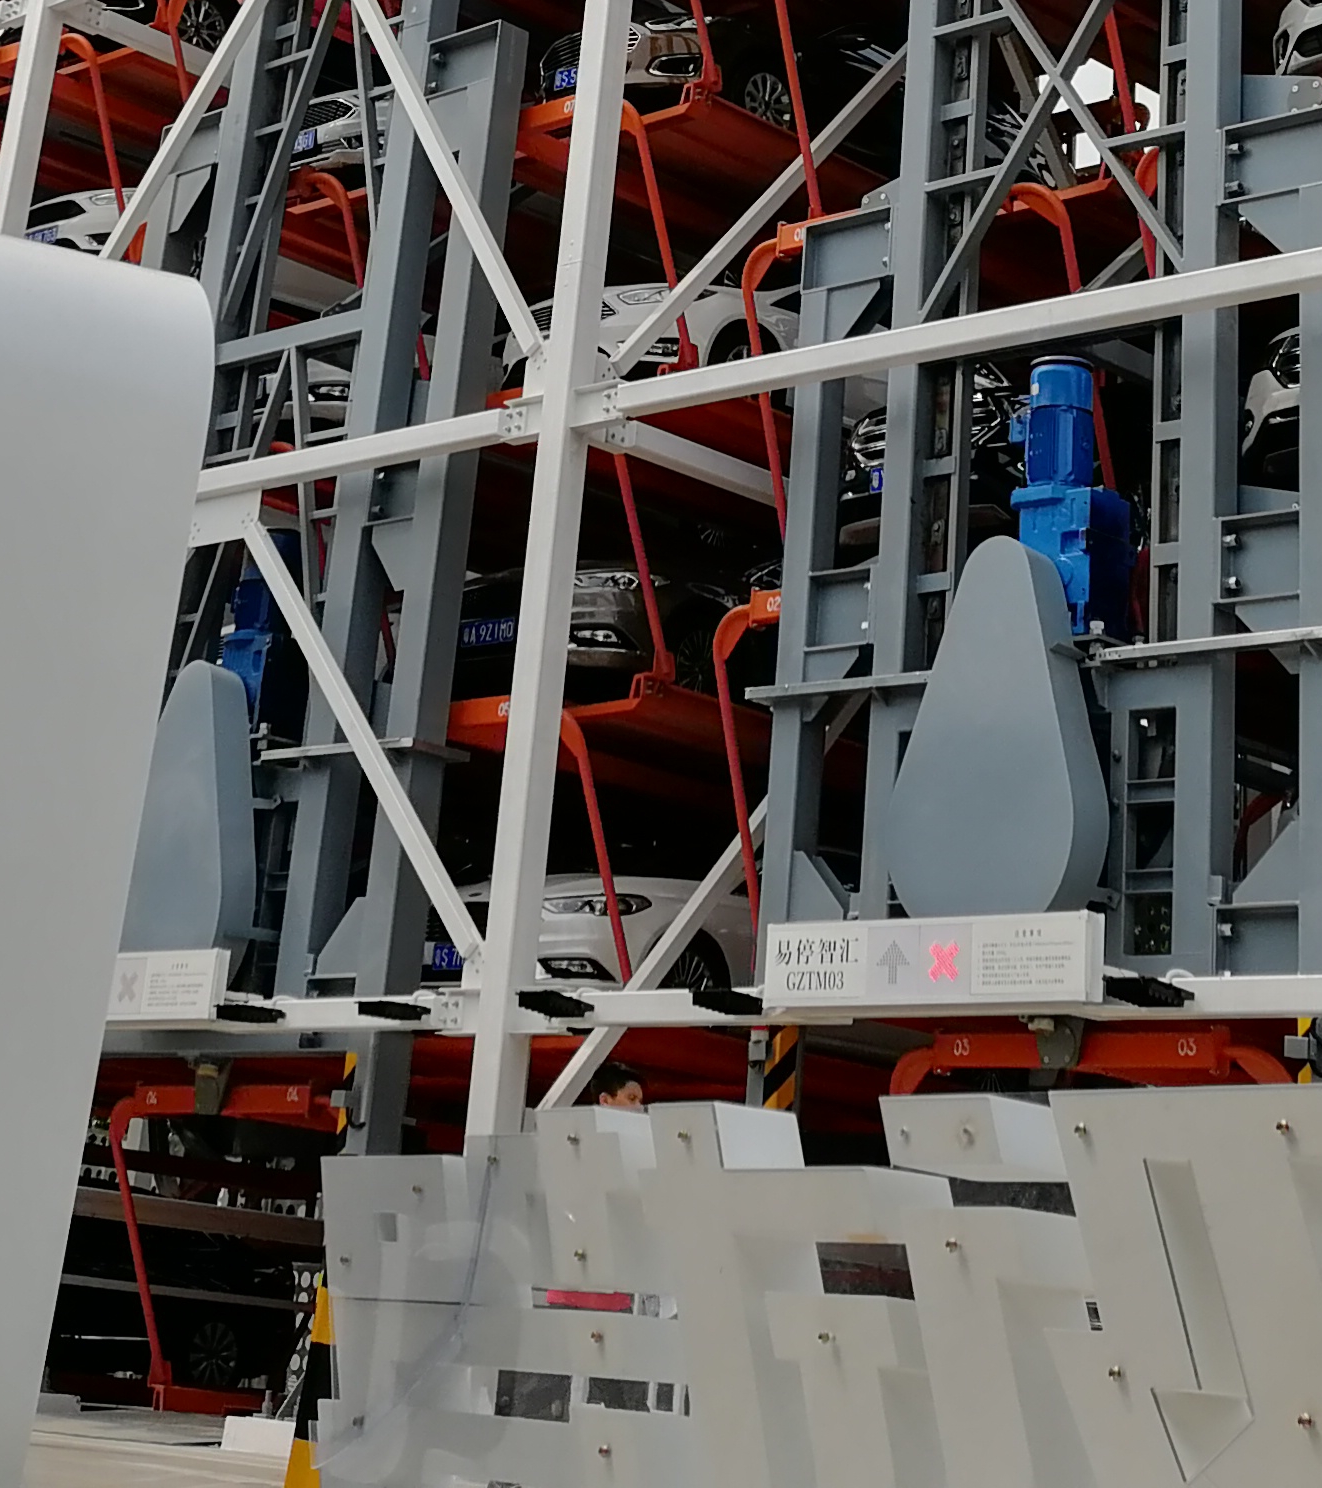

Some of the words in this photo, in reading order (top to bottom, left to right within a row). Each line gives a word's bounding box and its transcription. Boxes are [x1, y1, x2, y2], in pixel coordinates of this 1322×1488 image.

[776, 938, 858, 966] 易停智汇
[786, 971, 844, 991] GZTM03
[953, 1038, 970, 1056] 03
[1177, 1038, 1197, 1056] 03
